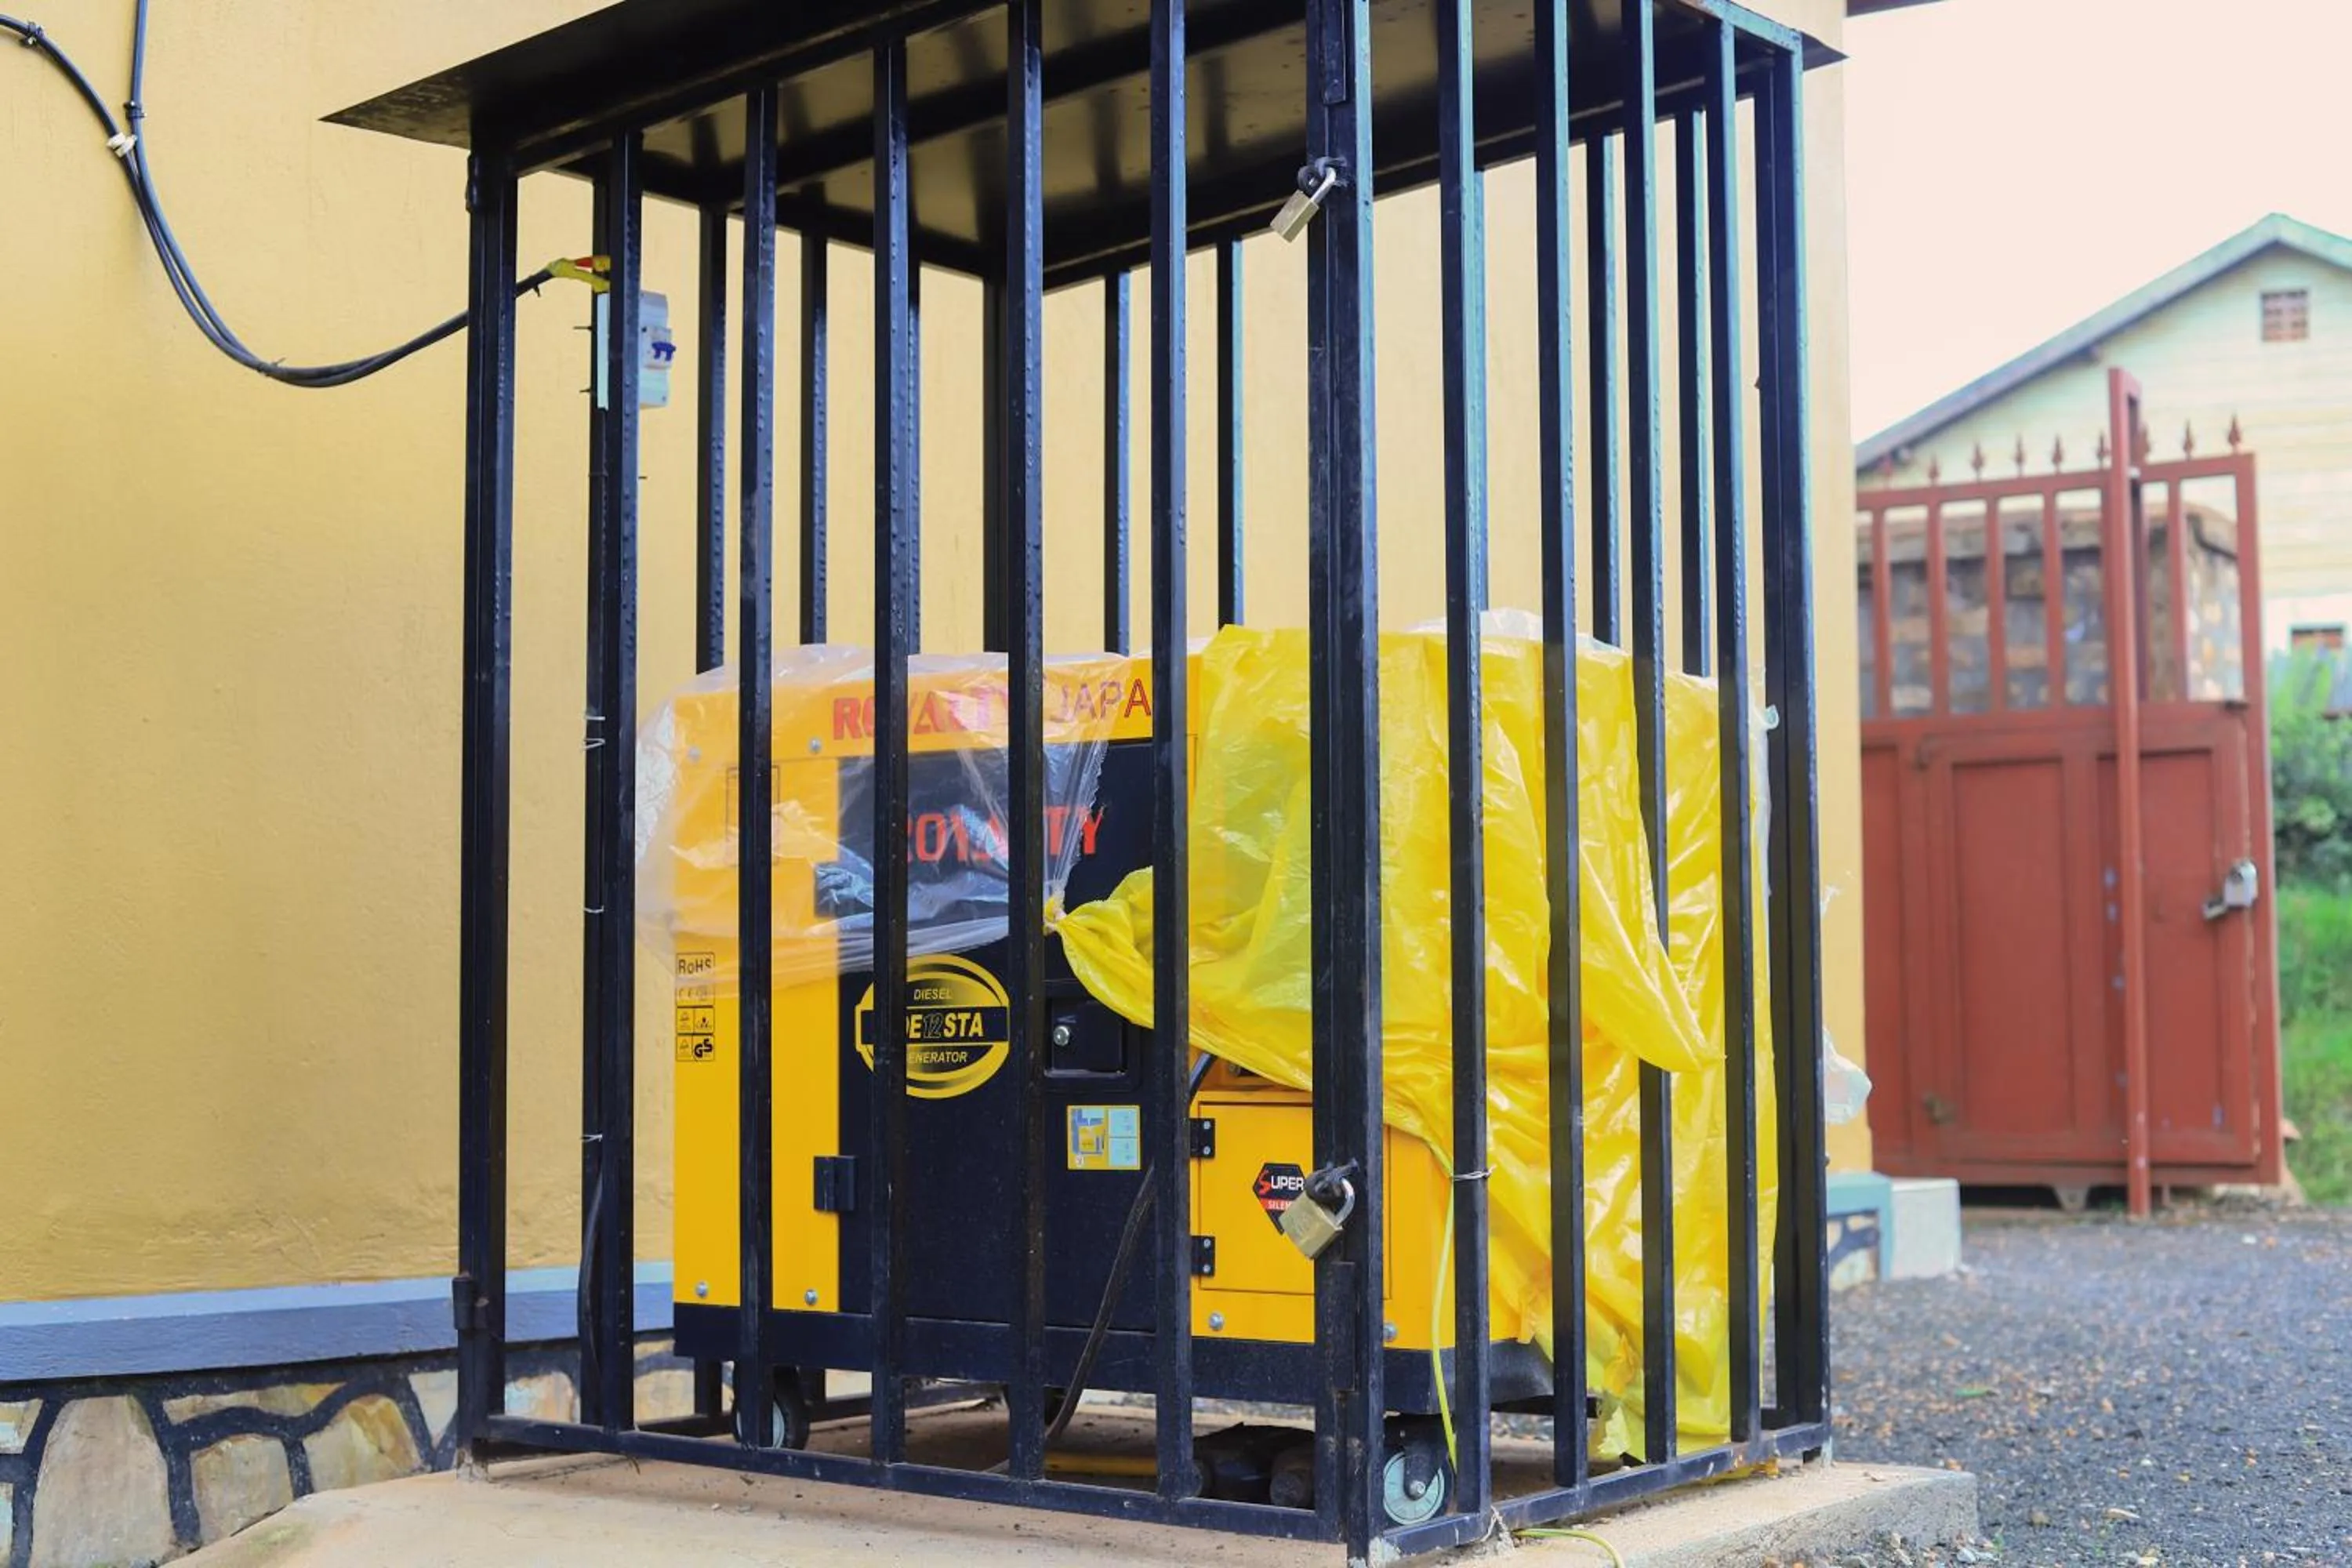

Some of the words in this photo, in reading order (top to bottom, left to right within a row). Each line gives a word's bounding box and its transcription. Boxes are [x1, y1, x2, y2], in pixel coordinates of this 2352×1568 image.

[1048, 677, 1152, 724] JAPA
[913, 988, 954, 1000] DIESEL
[694, 1037, 713, 1059] GS
[908, 1051, 968, 1065] ENERATOR
[1258, 1168, 1305, 1196] SUPER
[1267, 1199, 1293, 1210] SILEN
